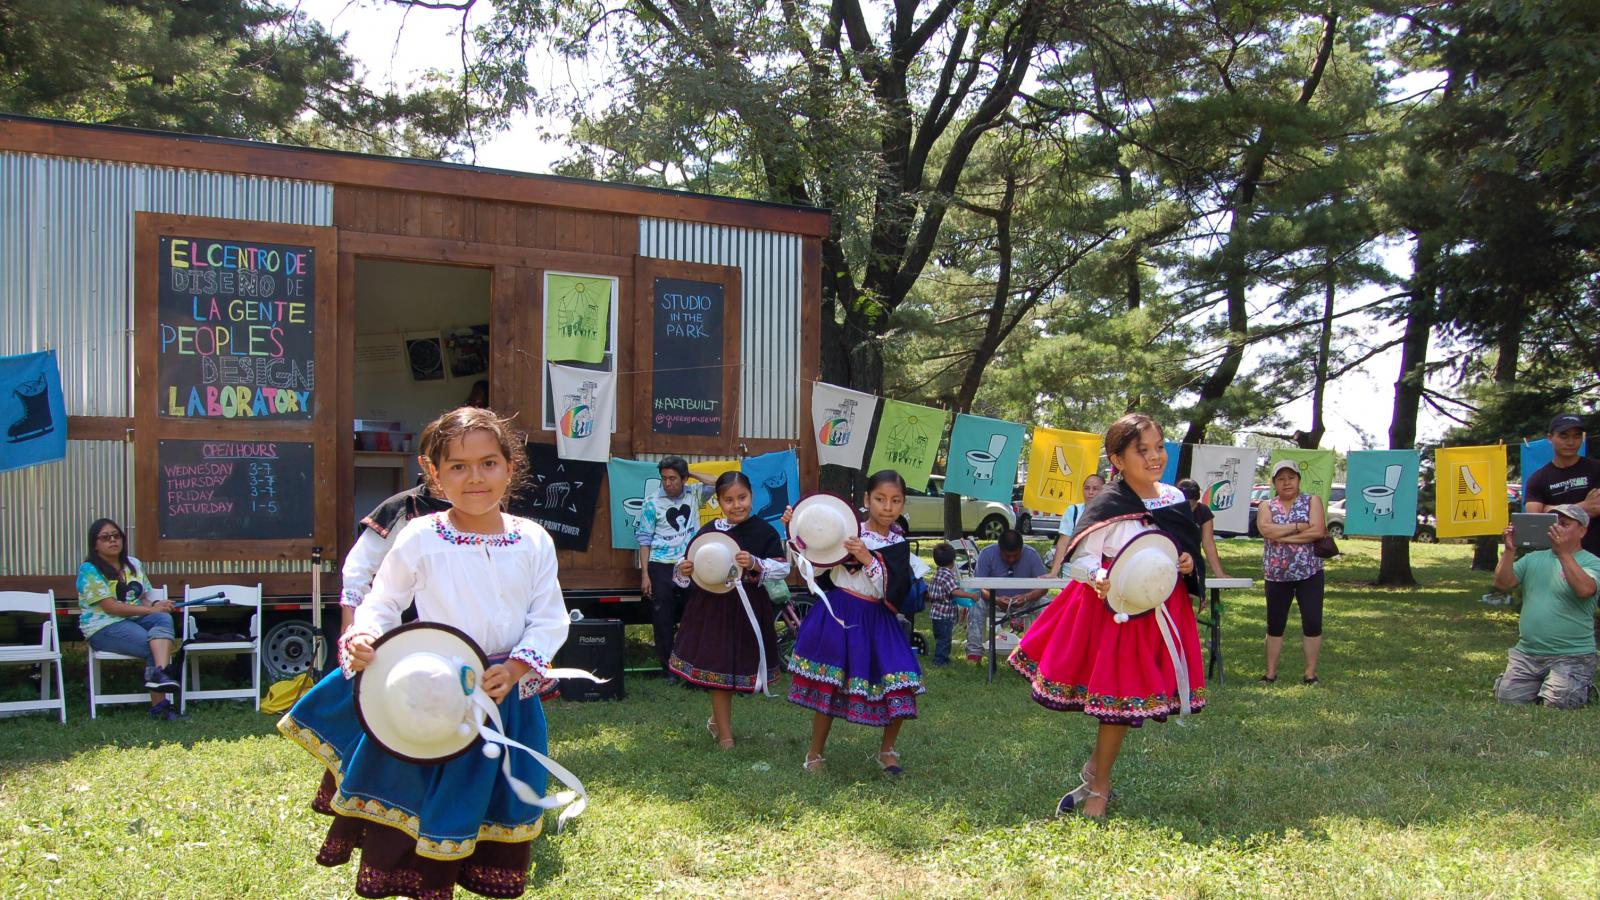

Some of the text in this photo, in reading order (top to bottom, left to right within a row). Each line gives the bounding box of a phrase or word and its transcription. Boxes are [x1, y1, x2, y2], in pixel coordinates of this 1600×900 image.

[285, 252, 307, 275] DE
[287, 278, 304, 297] DE
[193, 296, 306, 323] LA GENTE
[661, 293, 712, 311] STUDIO
[670, 312, 704, 323] IN THE
[666, 324, 710, 338] PARK
[202, 356, 314, 390] DESIGN
[168, 385, 310, 418] LABORATORY
[655, 397, 719, 411] #ARTBUILT
[203, 443, 279, 458] OPEN HOURS
[164, 462, 272, 477] WEDNESDAY 3-7
[167, 475, 275, 489] THURSDAY 3-7
[168, 486, 275, 503] FRIDAY 3-7
[168, 502, 234, 516] SATURDAY
[543, 519, 561, 531] PRINT
[561, 524, 580, 536] POWER
[579, 635, 606, 643] Roland
